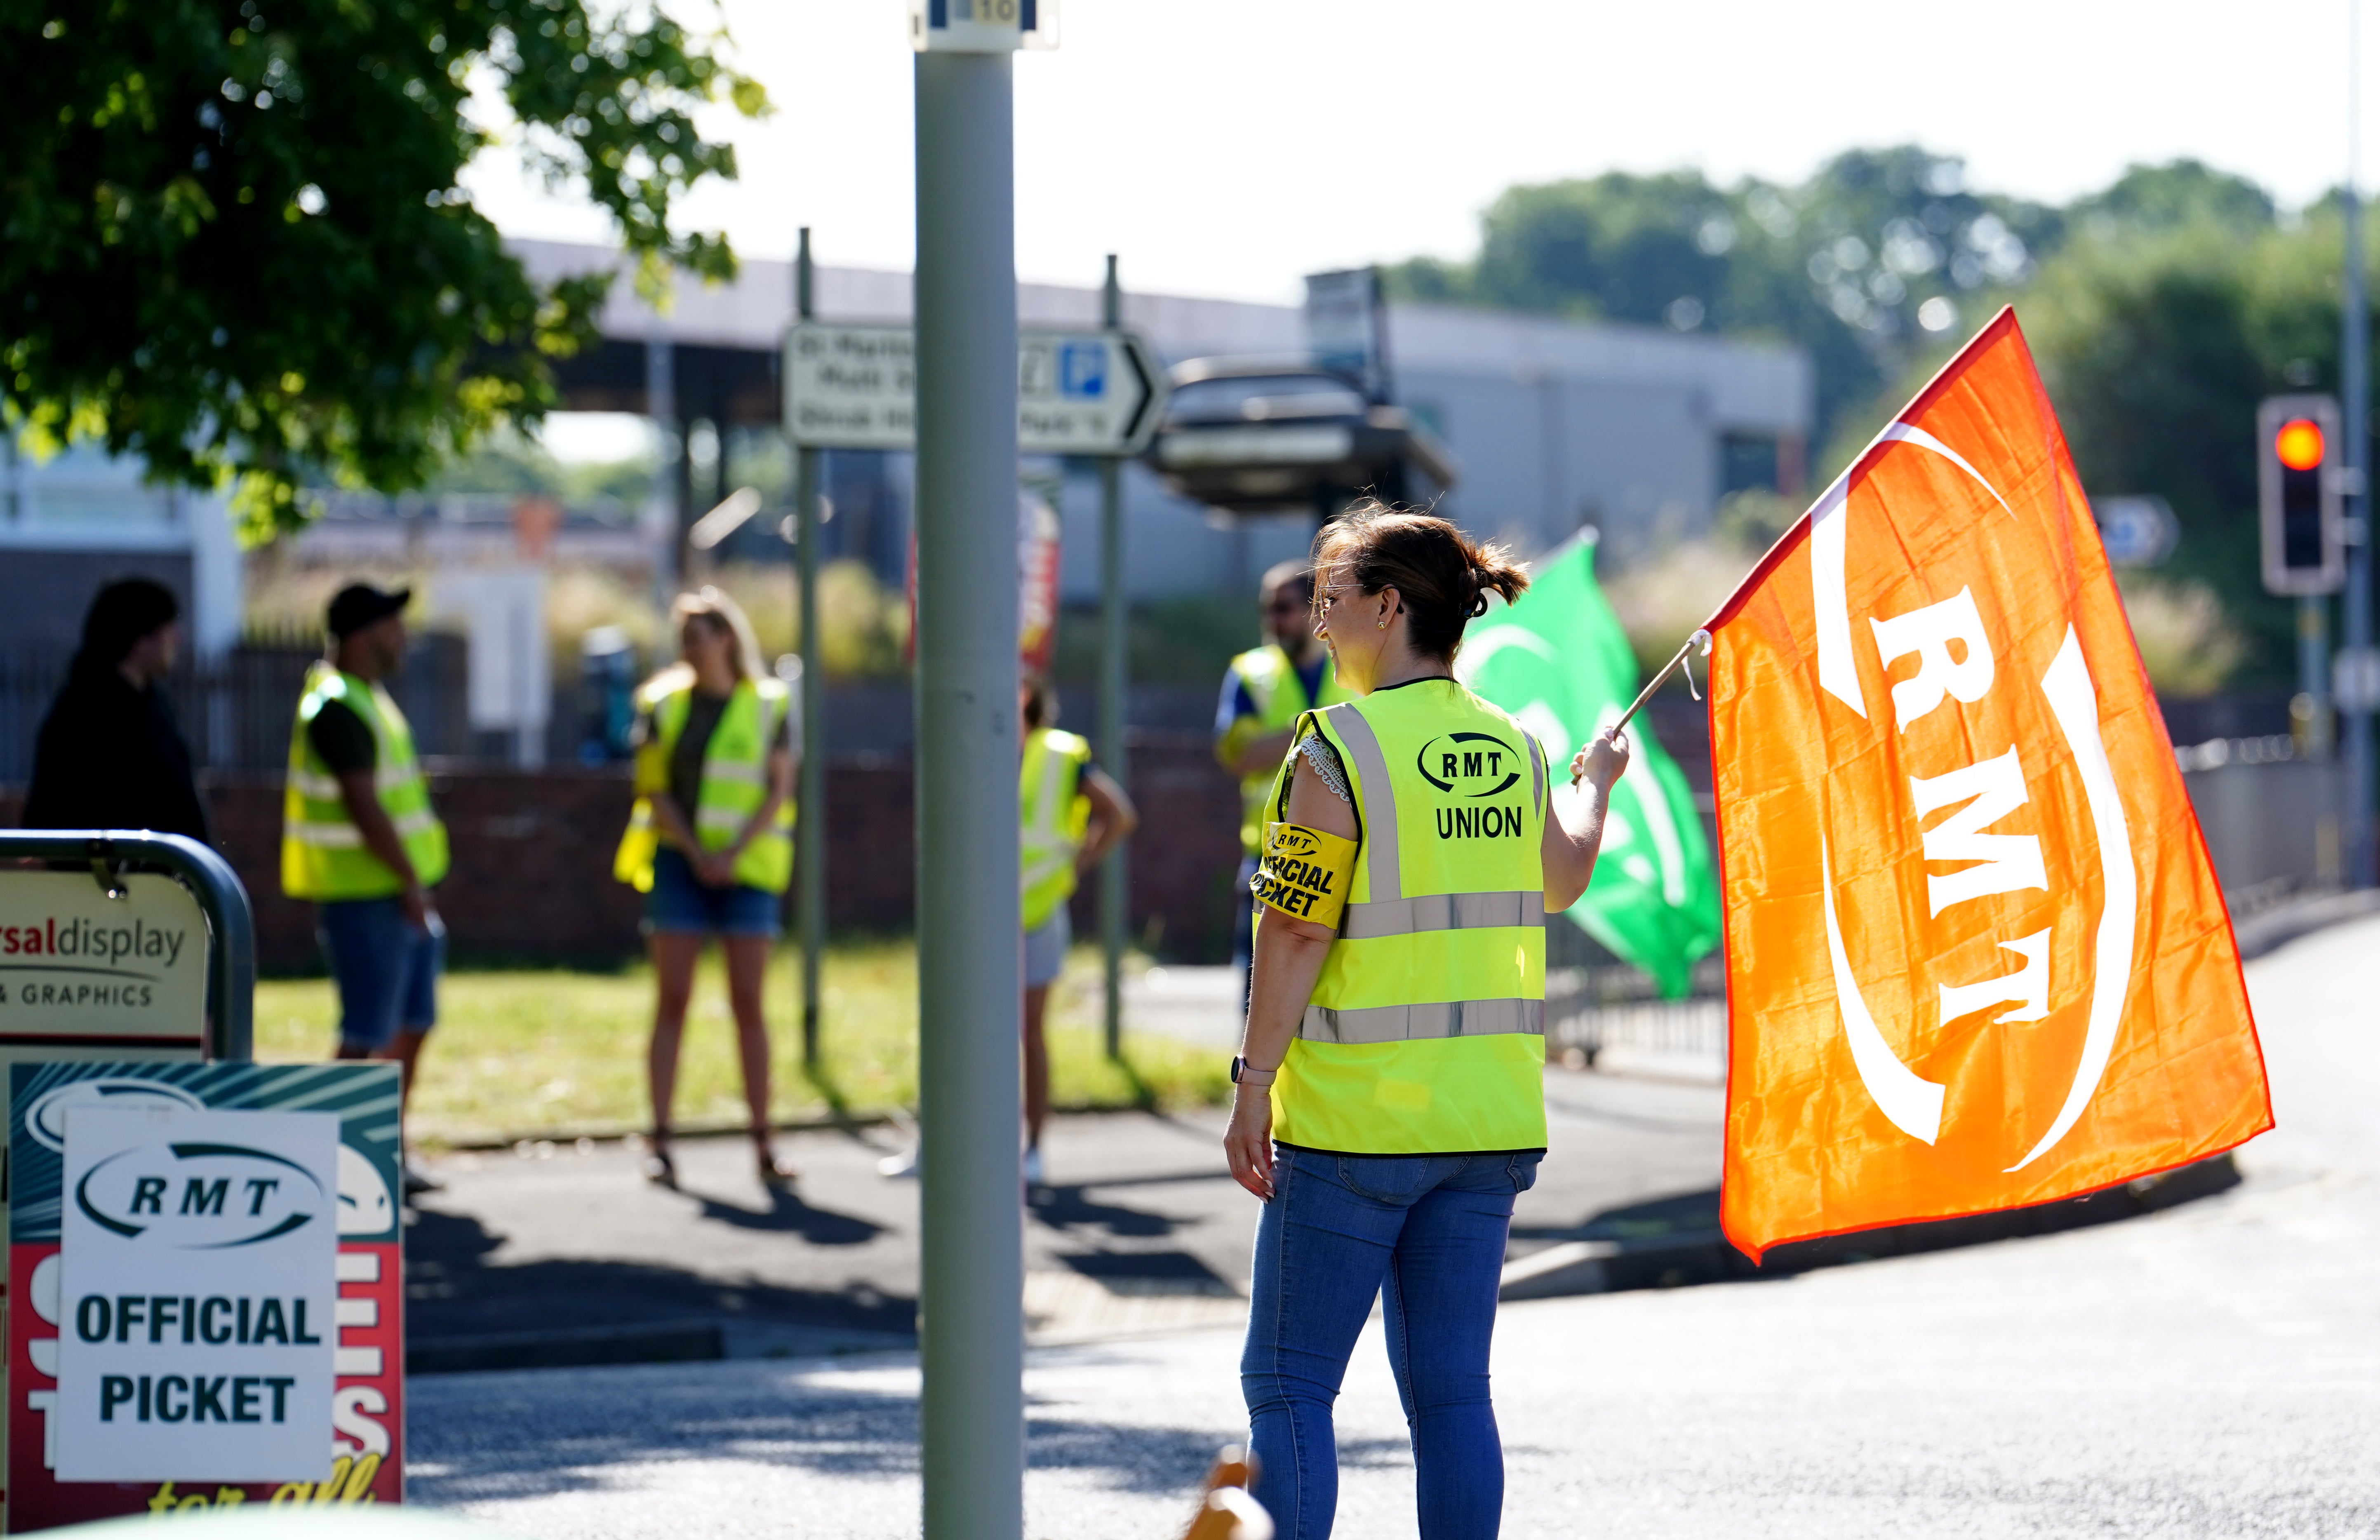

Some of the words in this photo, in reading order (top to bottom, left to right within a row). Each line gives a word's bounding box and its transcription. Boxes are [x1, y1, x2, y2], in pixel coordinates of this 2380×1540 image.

[1442, 752, 1502, 778] RMT
[1436, 806, 1522, 839] UNION
[1869, 585, 2052, 1027] RMT
[1278, 834, 1312, 849] RMT
[0, 917, 184, 967] saldisplay
[21, 984, 152, 1007] GRAPHICS
[129, 1177, 279, 1216] RMT
[76, 1295, 320, 1345] OFFICIAL
[100, 1375, 295, 1423] PICKET
